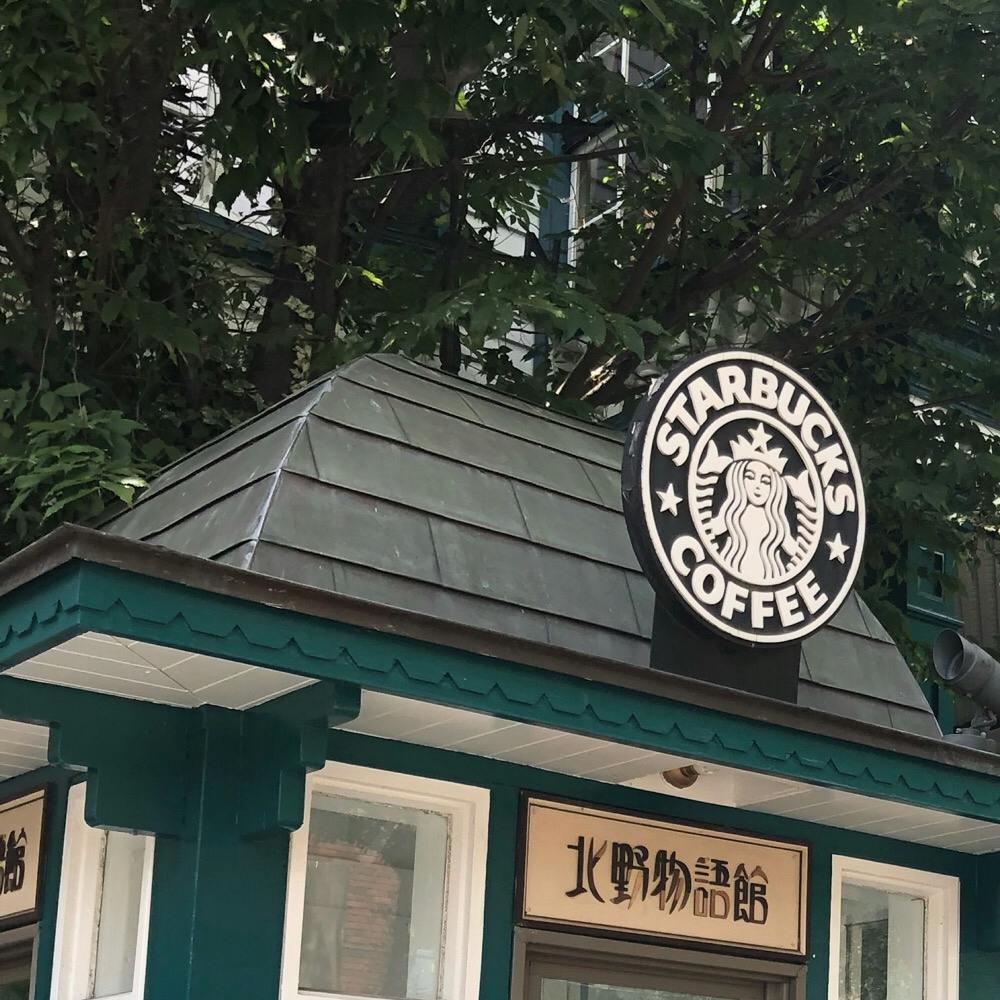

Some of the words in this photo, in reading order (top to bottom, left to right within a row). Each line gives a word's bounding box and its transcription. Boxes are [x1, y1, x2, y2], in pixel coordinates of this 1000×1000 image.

[656, 365, 855, 516] STARBUCKS
[671, 535, 829, 629] COFFEE
[565, 836, 769, 925] 北野物語館
